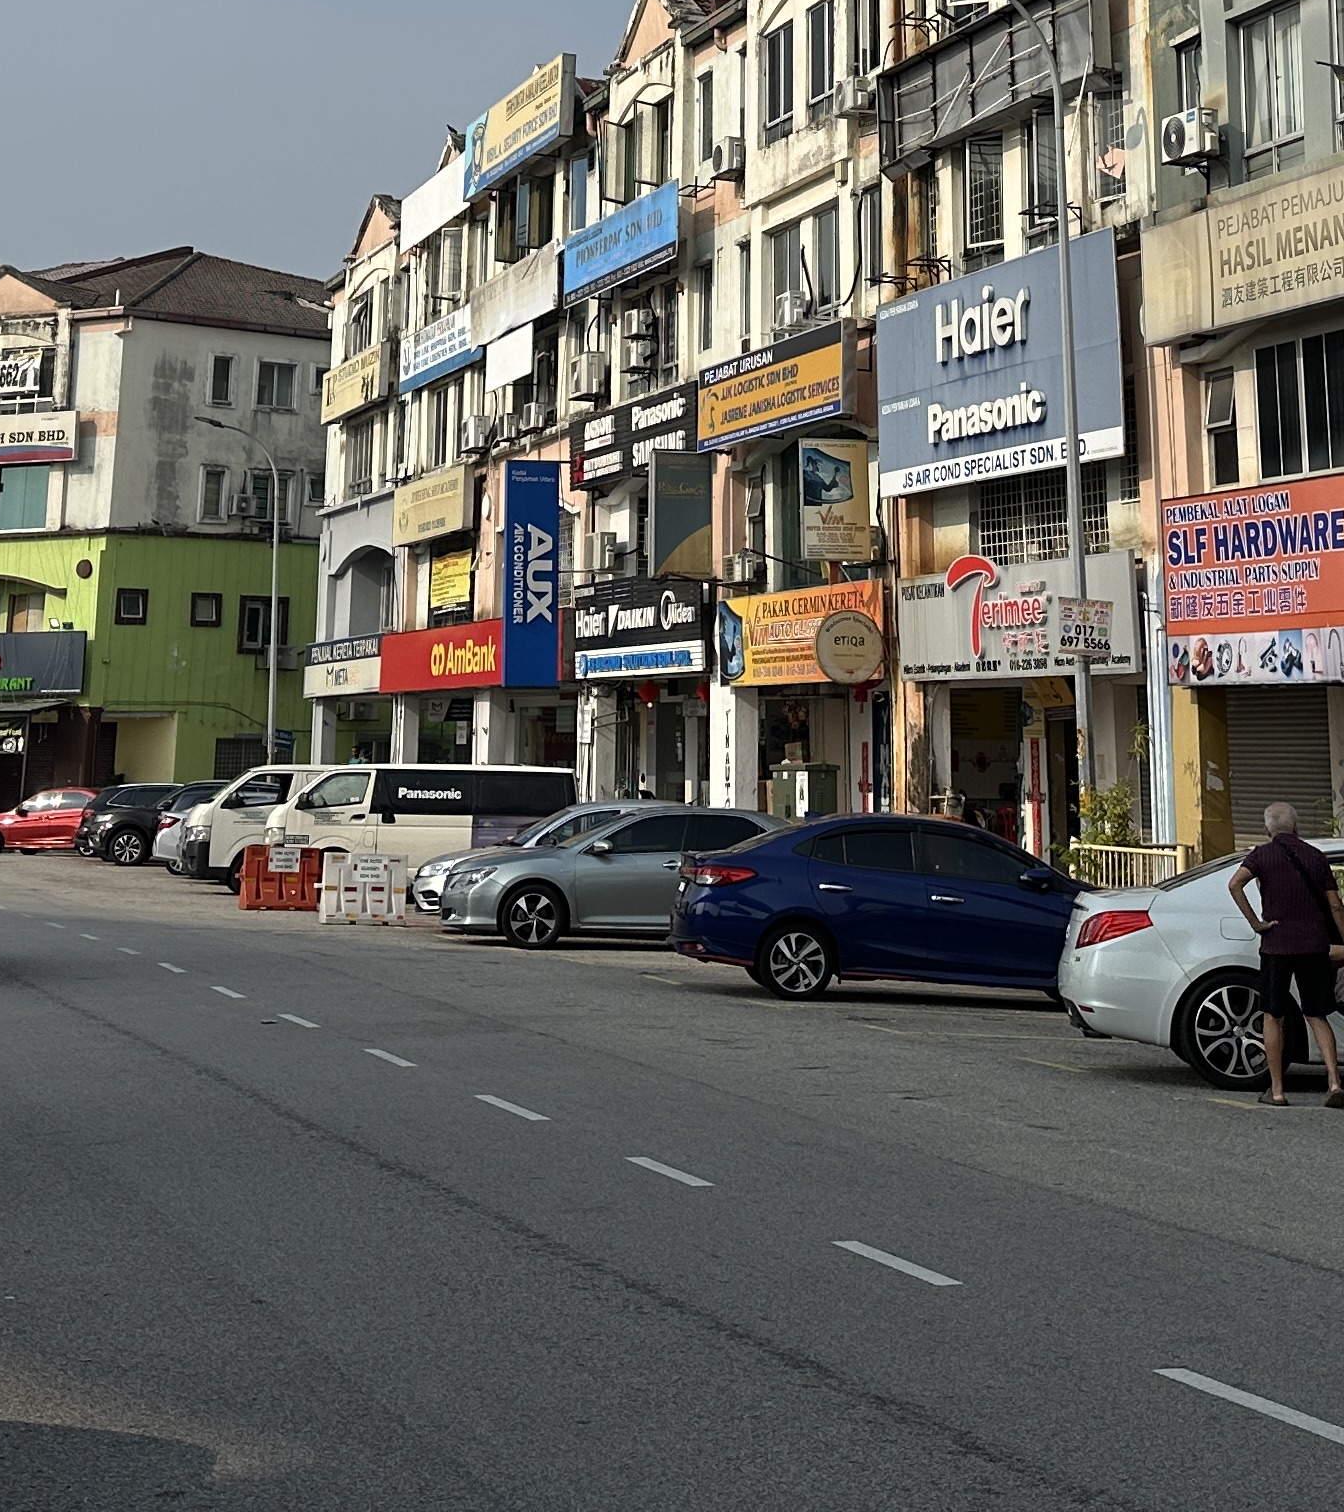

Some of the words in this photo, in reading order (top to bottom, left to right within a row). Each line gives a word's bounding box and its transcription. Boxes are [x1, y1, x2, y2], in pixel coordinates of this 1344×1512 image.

[1216, 201, 1278, 239] PEJABAT
[1281, 179, 1344, 220] PEMAJU
[1220, 235, 1273, 279] HASIL
[935, 284, 1031, 365] Haier
[704, 361, 739, 386] PEJABAT
[739, 348, 774, 374] URUSAN
[733, 373, 766, 396] LOGISTIC
[807, 375, 840, 400] SERVICES
[631, 391, 687, 432] Panasonic
[927, 381, 1048, 445] Panasonic
[8, 431, 35, 444] SDN
[37, 429, 66, 443] BHD
[902, 471, 914, 489] JS
[915, 467, 931, 487] AIR
[933, 461, 961, 483] COND
[963, 448, 1028, 478] SPECIALIST
[1029, 443, 1058, 464] SDN.
[1165, 501, 1220, 526] PEMBEKAL
[1222, 496, 1248, 518] ALAT
[1252, 490, 1291, 514] LOGAM
[1167, 526, 1208, 567] SLF
[525, 522, 554, 625] AUX
[1168, 573, 1177, 591] &
[1179, 566, 1242, 589] INDUSTRIAL
[1244, 562, 1279, 584] PARTS
[1280, 558, 1320, 581] SUPPLY
[575, 606, 607, 639] Haier
[617, 605, 656, 631] DAIKIN
[762, 598, 790, 620] PAKAR
[791, 593, 829, 617] CERMIN
[828, 589, 866, 611] KERETA
[1060, 634, 1080, 648] 697
[1074, 623, 1095, 638] 017
[333, 641, 353, 661] KERETA
[445, 636, 496, 676] AmBank
[398, 787, 462, 801] Panasonic
